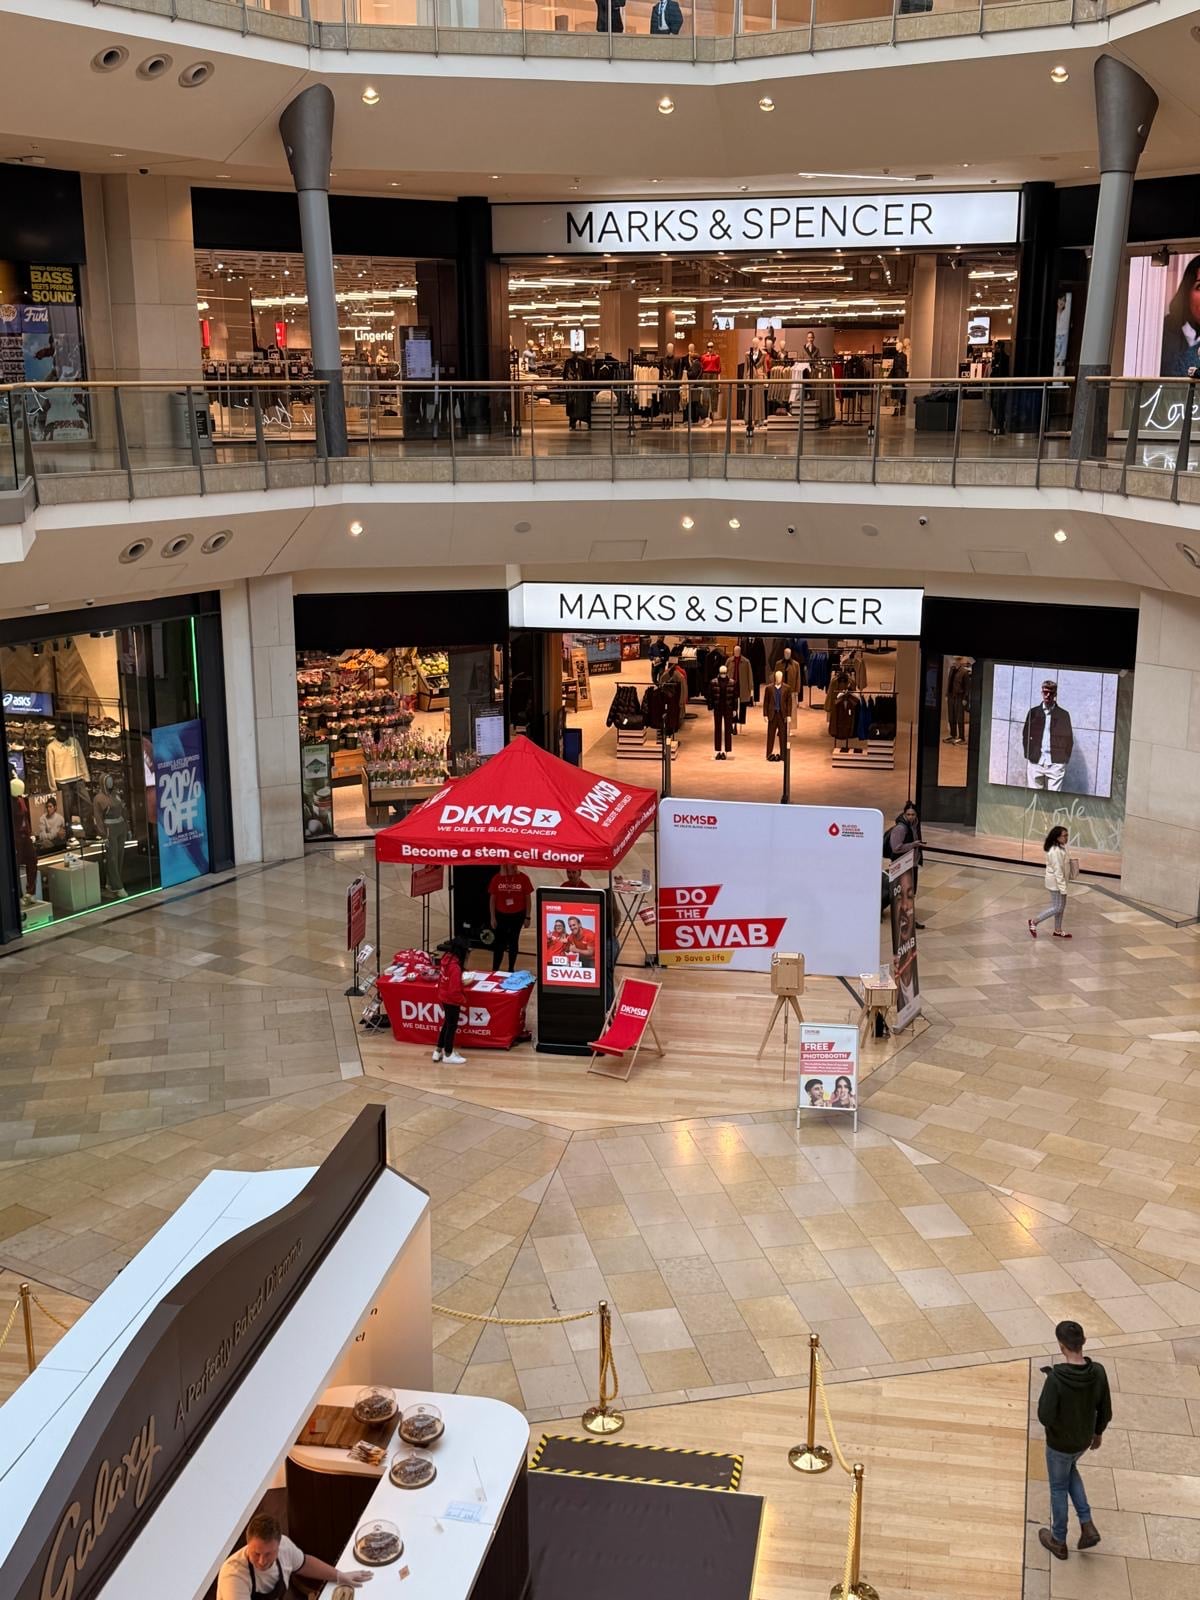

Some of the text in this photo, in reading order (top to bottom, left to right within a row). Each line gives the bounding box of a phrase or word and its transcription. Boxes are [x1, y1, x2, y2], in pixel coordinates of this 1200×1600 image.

[567, 203, 933, 244] MARKS & SPENCER
[30, 271, 74, 284] BASS
[32, 290, 75, 303] SOUND
[354, 329, 394, 343] Lingerie
[559, 593, 884, 625] MARKS & SPENCER
[158, 767, 201, 809] 20%
[163, 799, 198, 837] OFF
[439, 804, 532, 827] DKMS
[673, 814, 707, 825] DKMS
[402, 845, 585, 863] Become a stem cell donor
[675, 889, 707, 905] DO
[675, 909, 700, 919] THE
[675, 923, 769, 947] SWAB
[897, 936, 915, 959] SWAB
[684, 954, 704, 962] Save
[712, 953, 725, 961] life
[550, 968, 592, 980] SWAB
[415, 1023, 437, 1031] DELETE
[463, 1028, 491, 1036] CANCER
[804, 1043, 829, 1051] FREE
[187, 1338, 233, 1410] Perfectly
[234, 1288, 263, 1345] Baked
[41, 1415, 162, 1600] Galaxy
